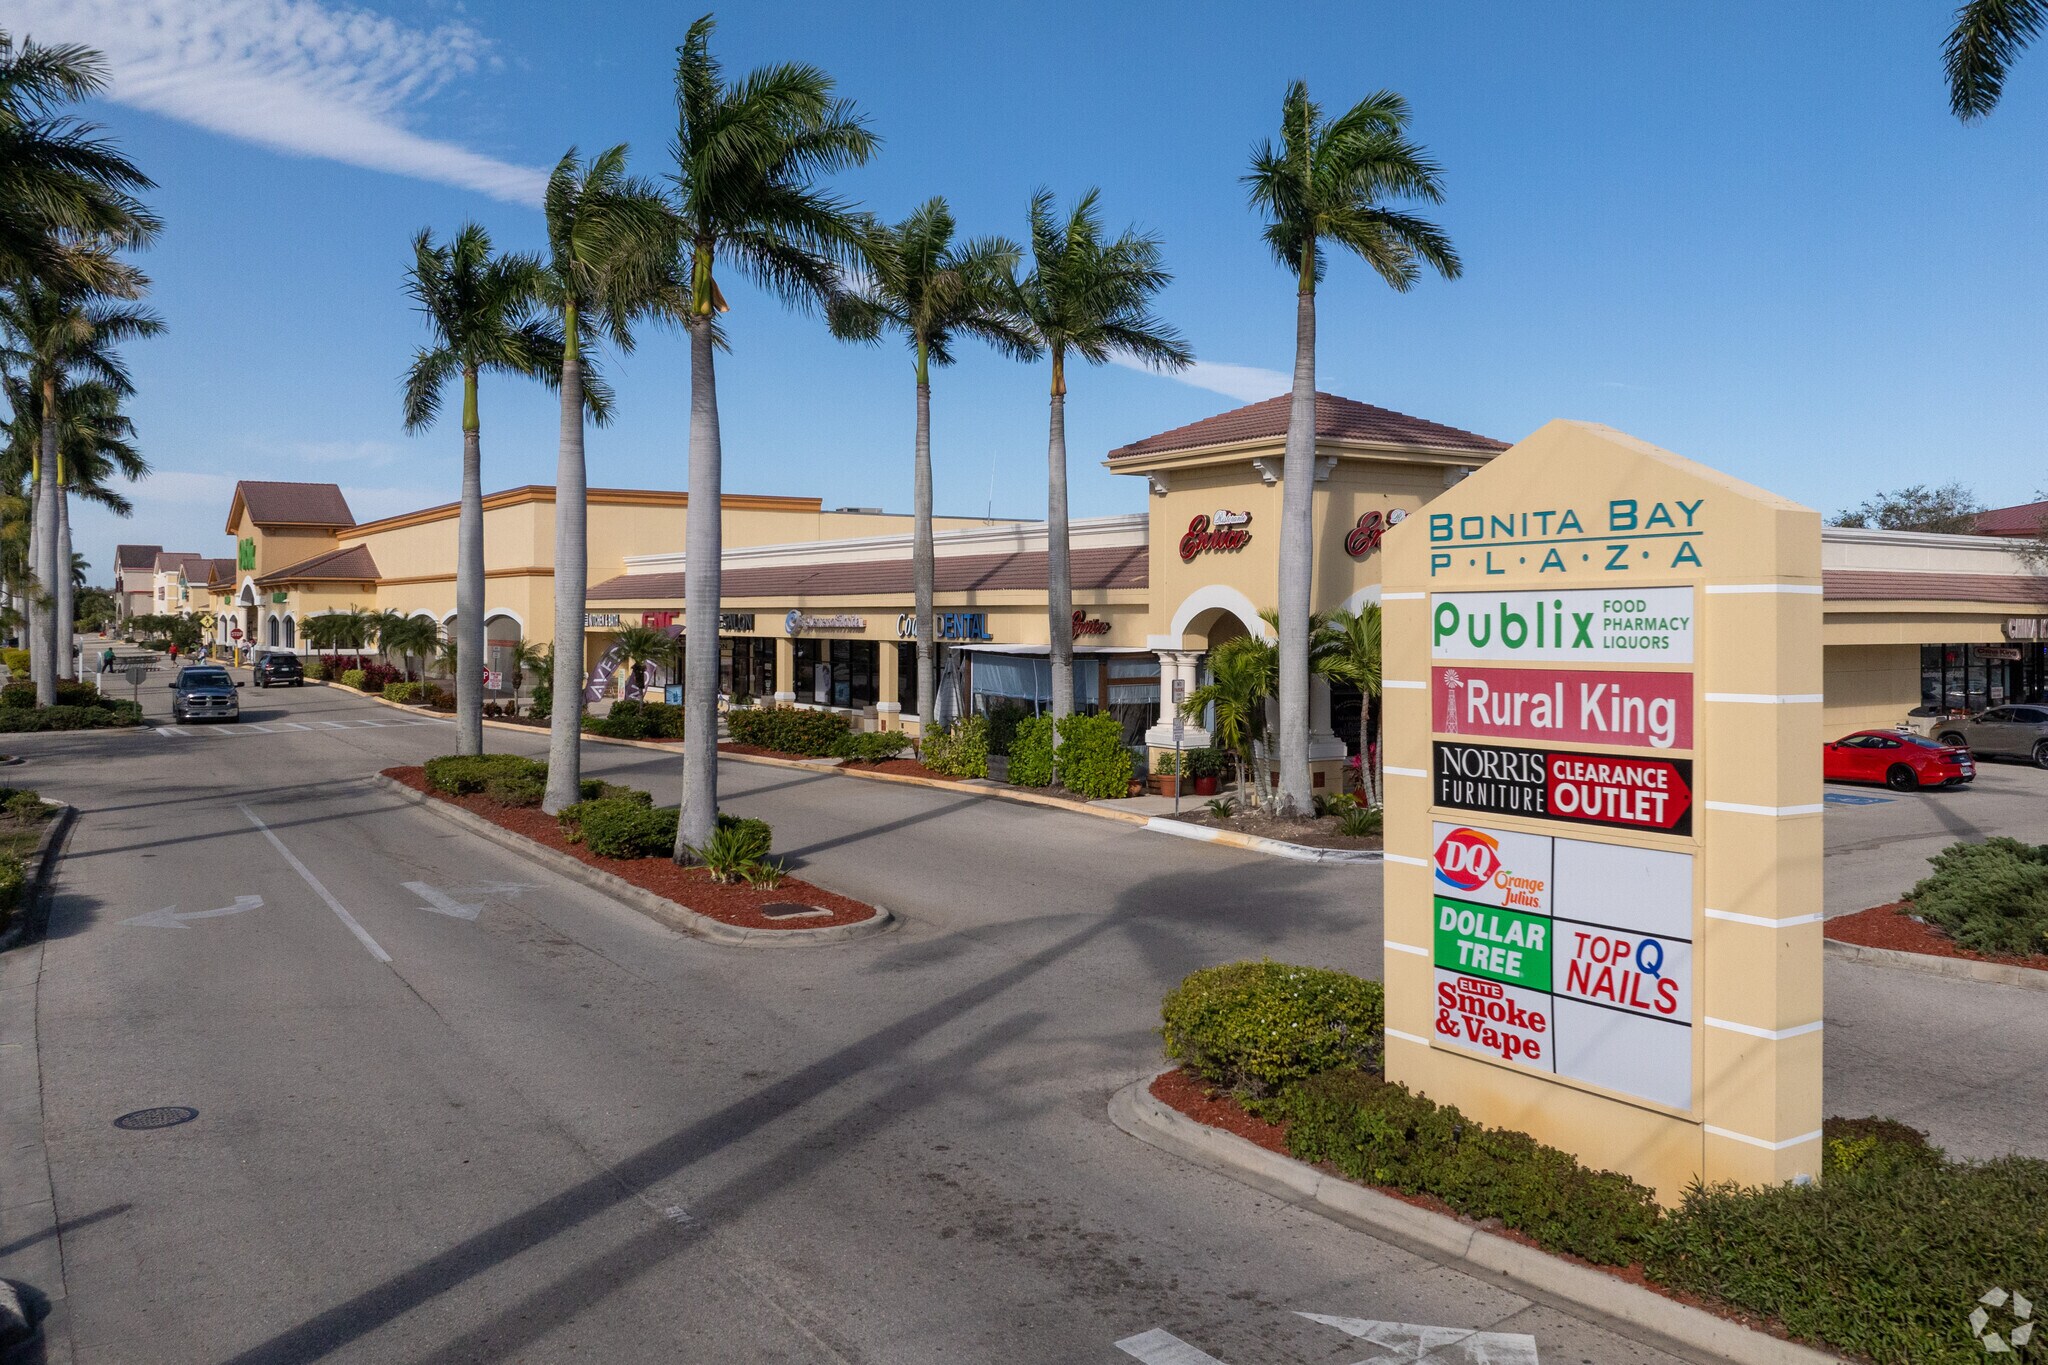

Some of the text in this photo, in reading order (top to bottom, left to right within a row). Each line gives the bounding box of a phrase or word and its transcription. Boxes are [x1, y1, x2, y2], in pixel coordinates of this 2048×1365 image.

[1179, 514, 1247, 560] Enrico
[1430, 509, 1584, 542] BONITA
[1609, 499, 1704, 531] BAY
[723, 614, 752, 630] SALON
[936, 613, 990, 639] DENTAL
[1434, 599, 1594, 649] Publix
[1603, 600, 1647, 613] FOOD
[1603, 617, 1690, 631] PHARMACY
[1603, 636, 1669, 650] LIQUORS
[1467, 679, 1676, 749] Rural King
[1441, 746, 1546, 784] NORRIS
[1552, 760, 1669, 789] CLEARANCE
[1442, 779, 1545, 813] FURNITURE
[1554, 782, 1669, 823] OUTLET
[1443, 840, 1492, 882] DQ
[1494, 870, 1544, 894] Orange
[1439, 906, 1546, 951] DOLLAR
[1456, 940, 1522, 977] TREE
[1574, 932, 1664, 980] TOP Q
[1460, 978, 1502, 996] ELITE
[1566, 959, 1679, 1014] NAILS
[1438, 981, 1546, 1033] Smoke
[1435, 1008, 1541, 1060] & Vape
